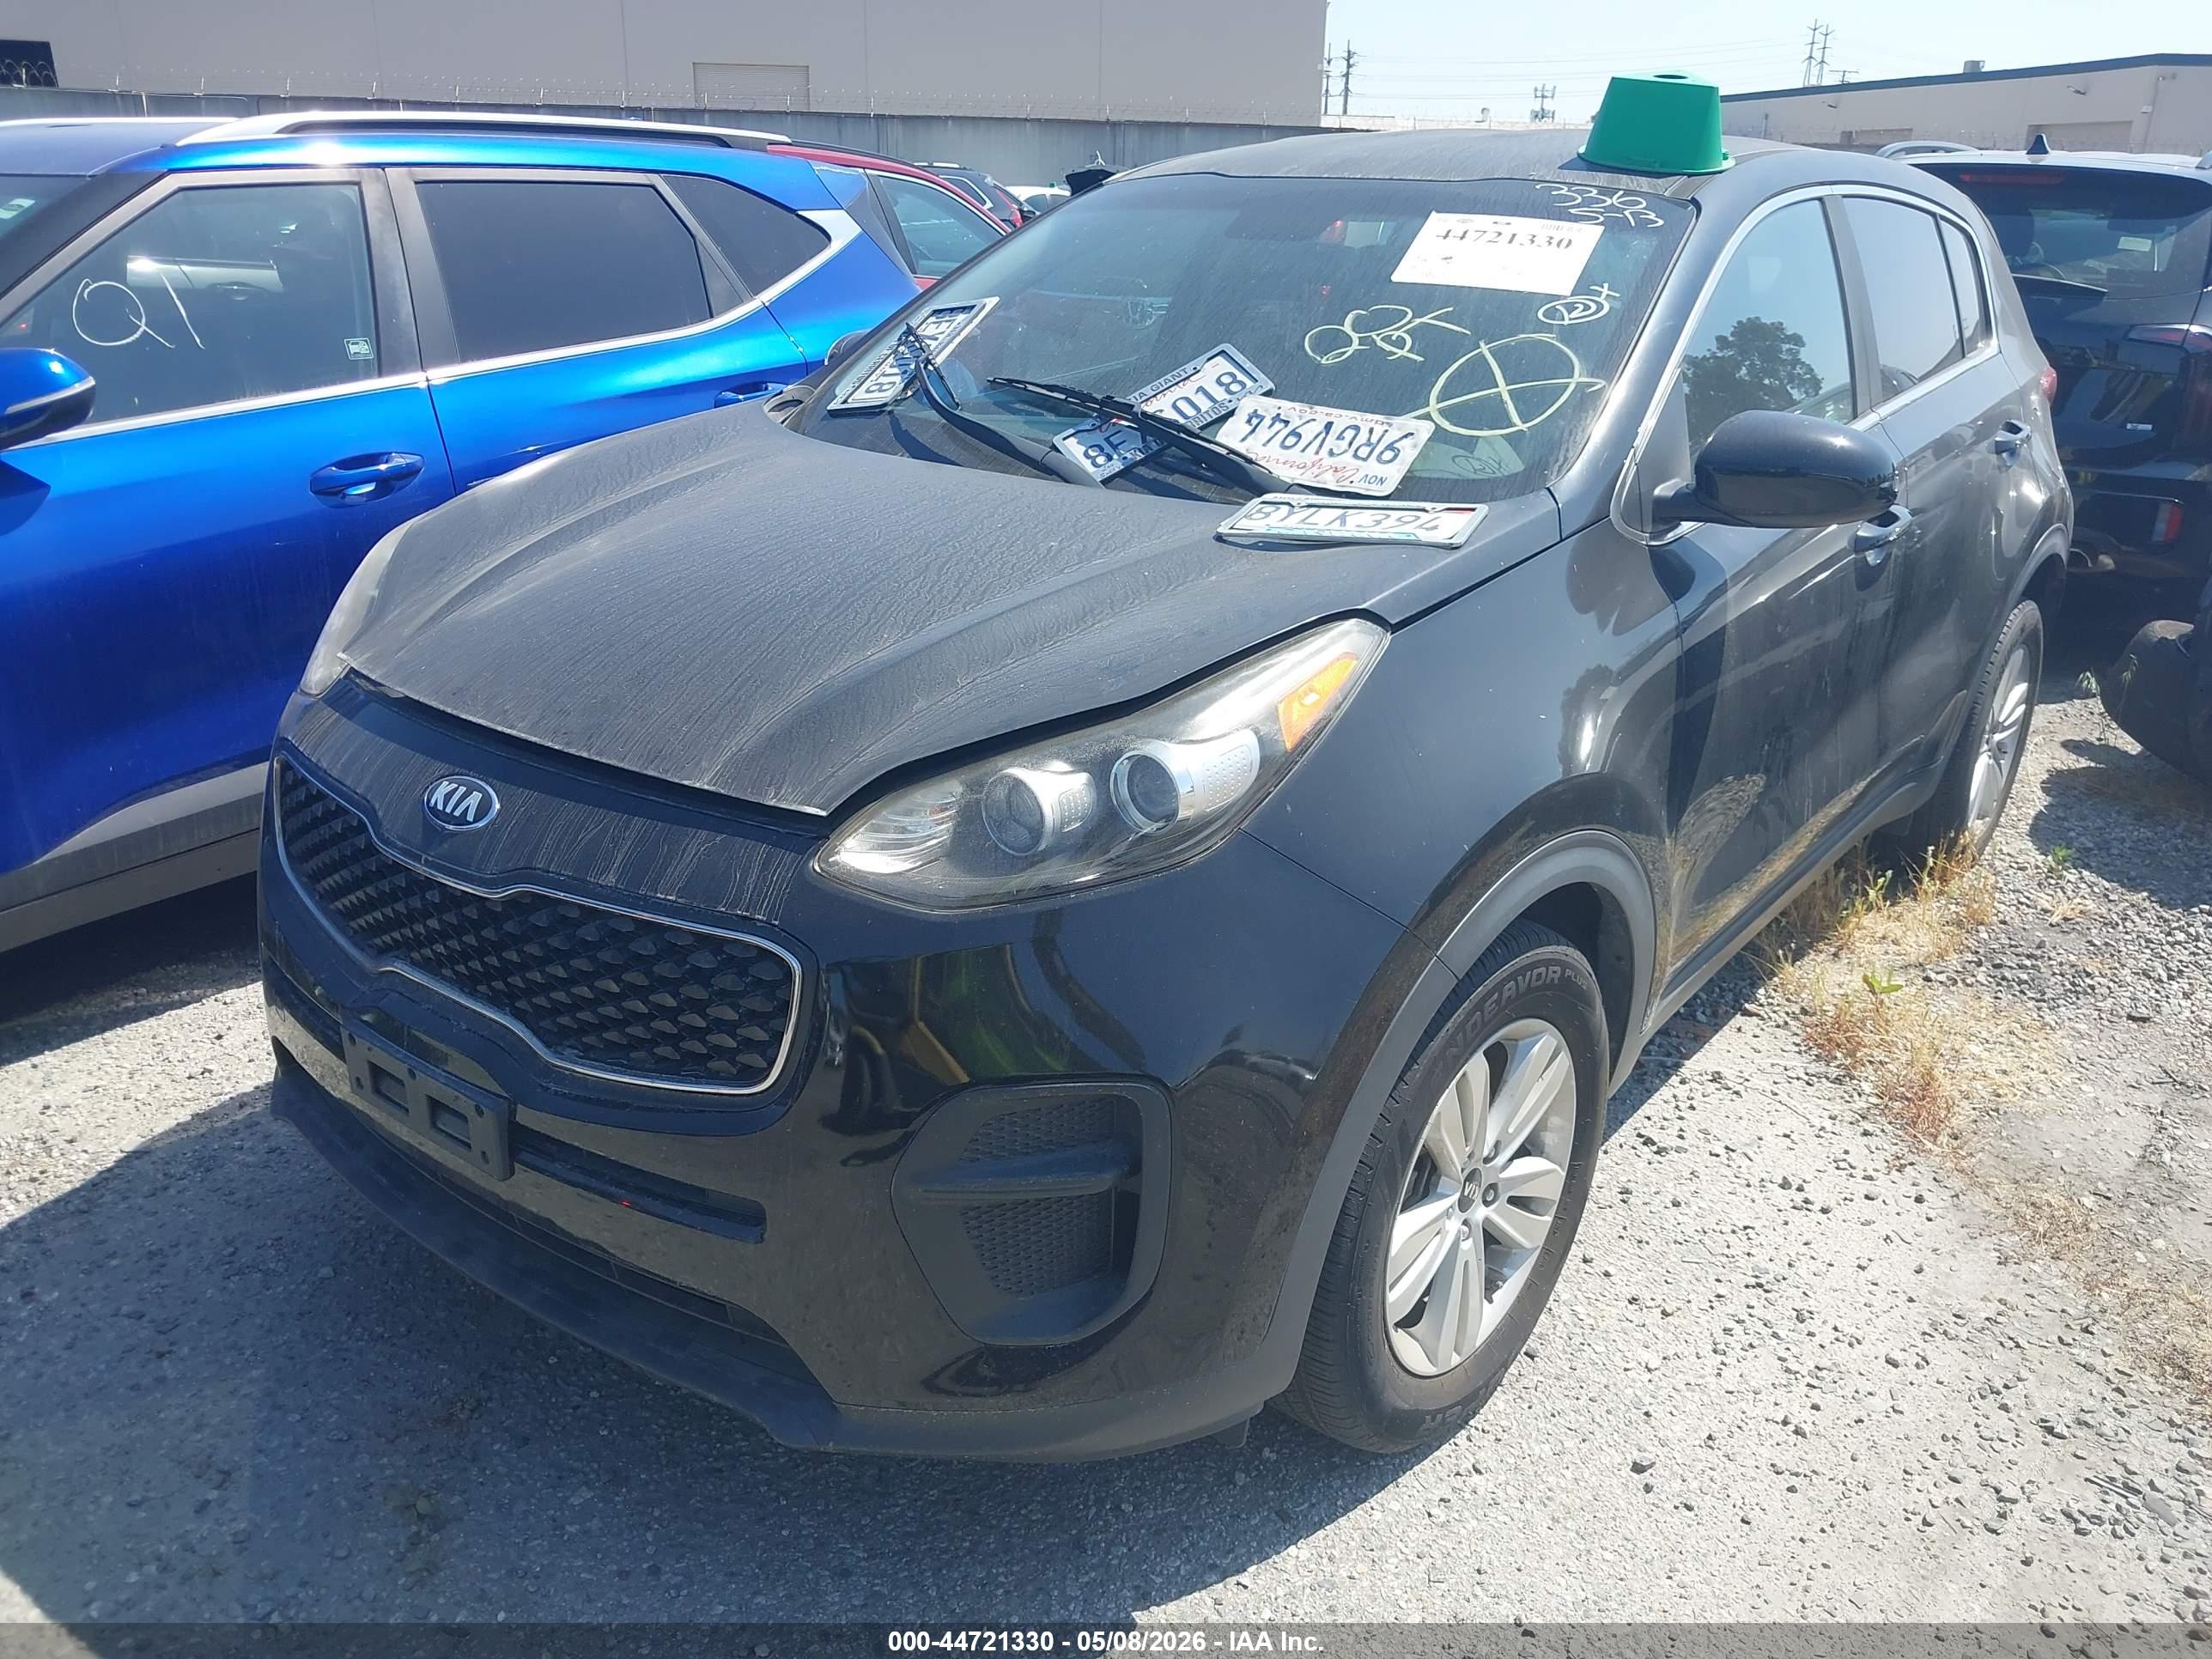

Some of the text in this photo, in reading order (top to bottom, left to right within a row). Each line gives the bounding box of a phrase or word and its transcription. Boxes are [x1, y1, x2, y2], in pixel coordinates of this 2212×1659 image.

[1535, 183, 1647, 210] 336
[1436, 228, 1573, 250] 44721330
[1127, 367, 1189, 402] IA GIANT
[1240, 408, 1415, 465] 9RGV944
[1245, 450, 1359, 483] California
[1358, 474, 1388, 487] NOV
[1246, 505, 1441, 531] 8YLK394
[429, 781, 483, 823] KIA
[1564, 968, 1588, 990] PLUS
